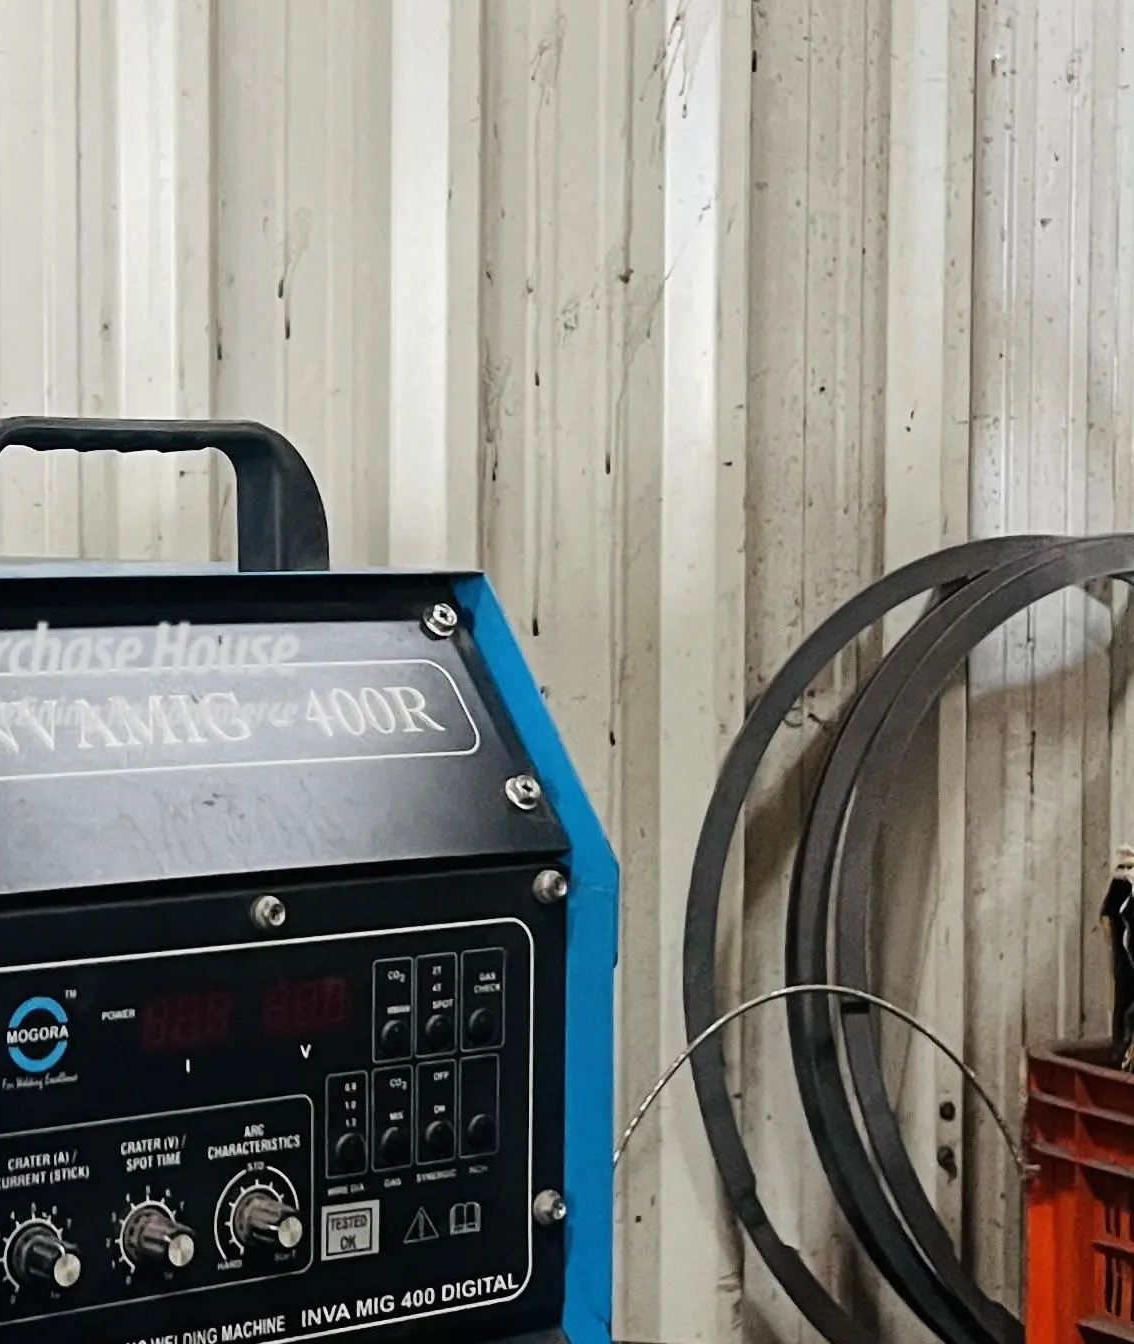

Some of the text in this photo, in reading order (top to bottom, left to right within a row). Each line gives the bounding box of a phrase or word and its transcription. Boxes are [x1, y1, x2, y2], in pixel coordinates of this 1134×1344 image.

[306, 686, 446, 738] 400R
[6, 1024, 69, 1044] MOGORA
[299, 1043, 312, 1059] V
[244, 1123, 265, 1138] ARC
[120, 1137, 162, 1156] CRATER
[207, 1134, 301, 1160] CHARACTERISTICS
[7, 1152, 51, 1172] CRATER
[126, 1151, 181, 1172] SPOT TIME
[330, 1214, 367, 1231] TESTED
[340, 1235, 357, 1250] OK
[301, 1272, 519, 1328] INVA MIG 400 DIGITAL
[221, 1314, 286, 1343] MACHINE
